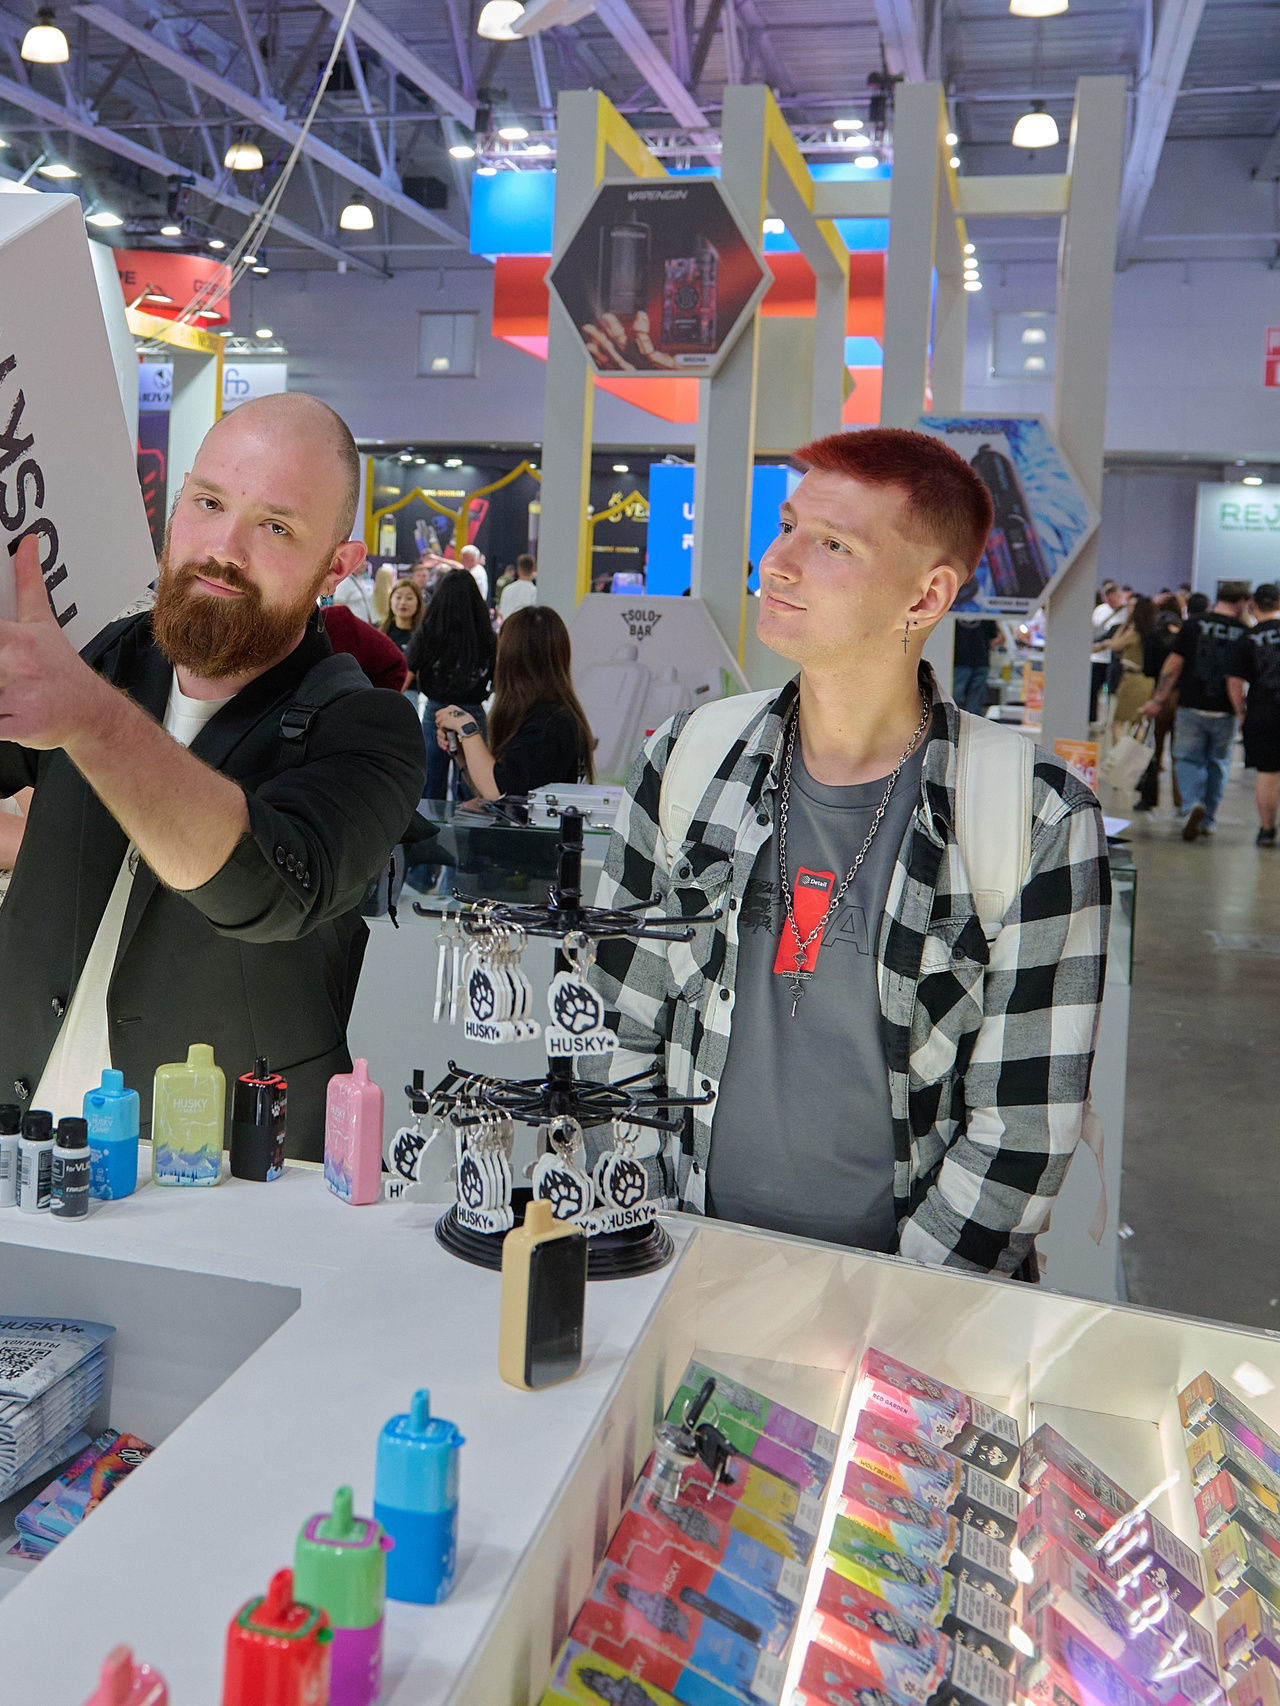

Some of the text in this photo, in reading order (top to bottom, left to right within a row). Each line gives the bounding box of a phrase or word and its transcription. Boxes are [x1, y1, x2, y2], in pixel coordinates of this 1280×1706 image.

[628, 610, 656, 622] SOLO
[629, 624, 652, 636] BAR
[810, 878, 828, 888] Detail
[173, 1098, 208, 1109] HUSKY
[330, 1103, 346, 1119] HUSKY
[2, 1340, 61, 1348] КОНТАКТЫ
[872, 1393, 909, 1415] RED GARDEN
[965, 1434, 980, 1457] HUSKY
[860, 1459, 897, 1482] WOLFBERRY
[661, 1560, 681, 1594] HUSKY
[847, 1650, 872, 1667] RIVER
